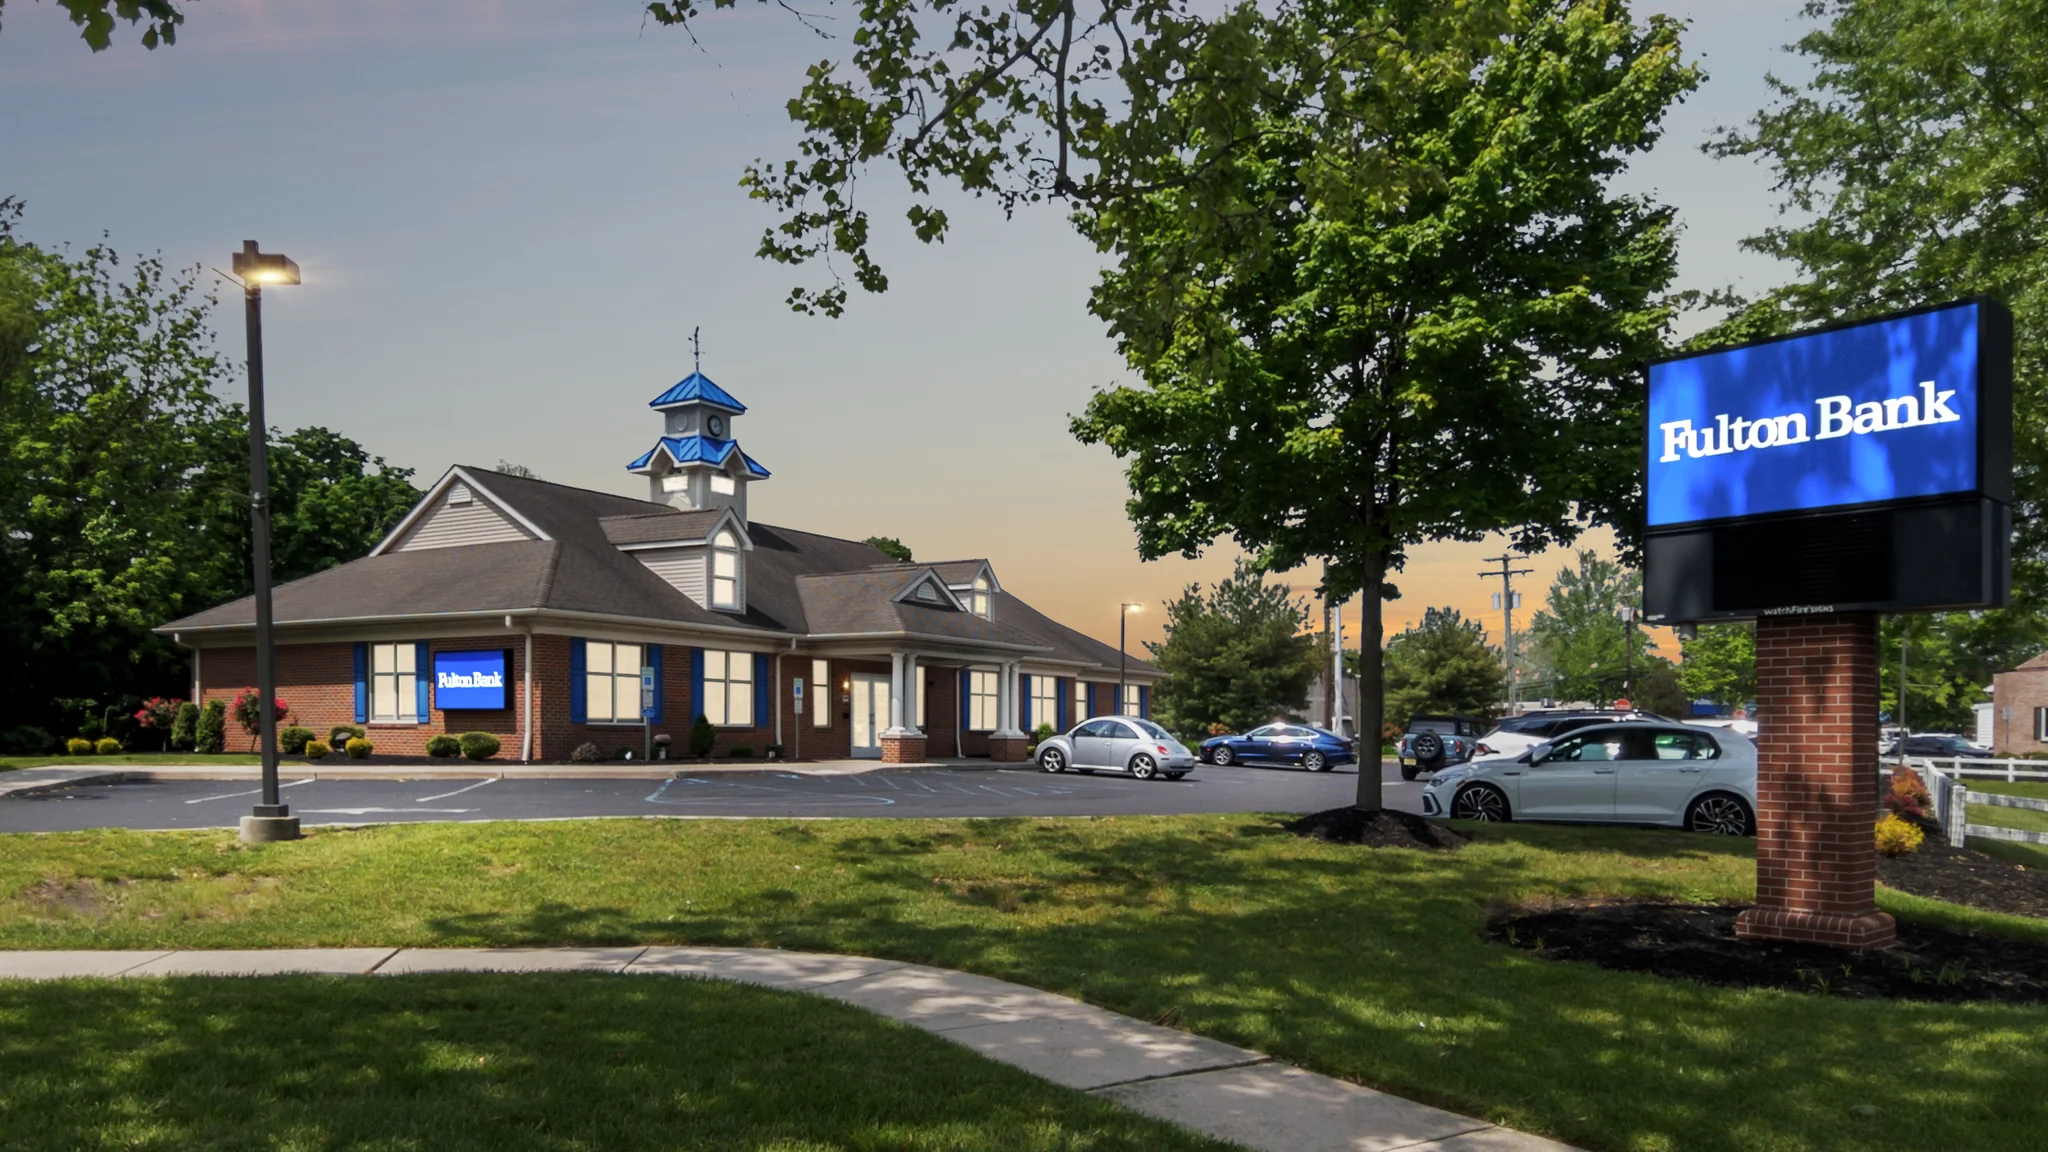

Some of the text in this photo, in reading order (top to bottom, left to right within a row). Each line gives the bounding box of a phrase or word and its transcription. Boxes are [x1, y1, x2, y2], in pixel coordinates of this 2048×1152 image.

[1659, 380, 1961, 463] Fulton Bank
[437, 671, 503, 688] Fulton Bank
